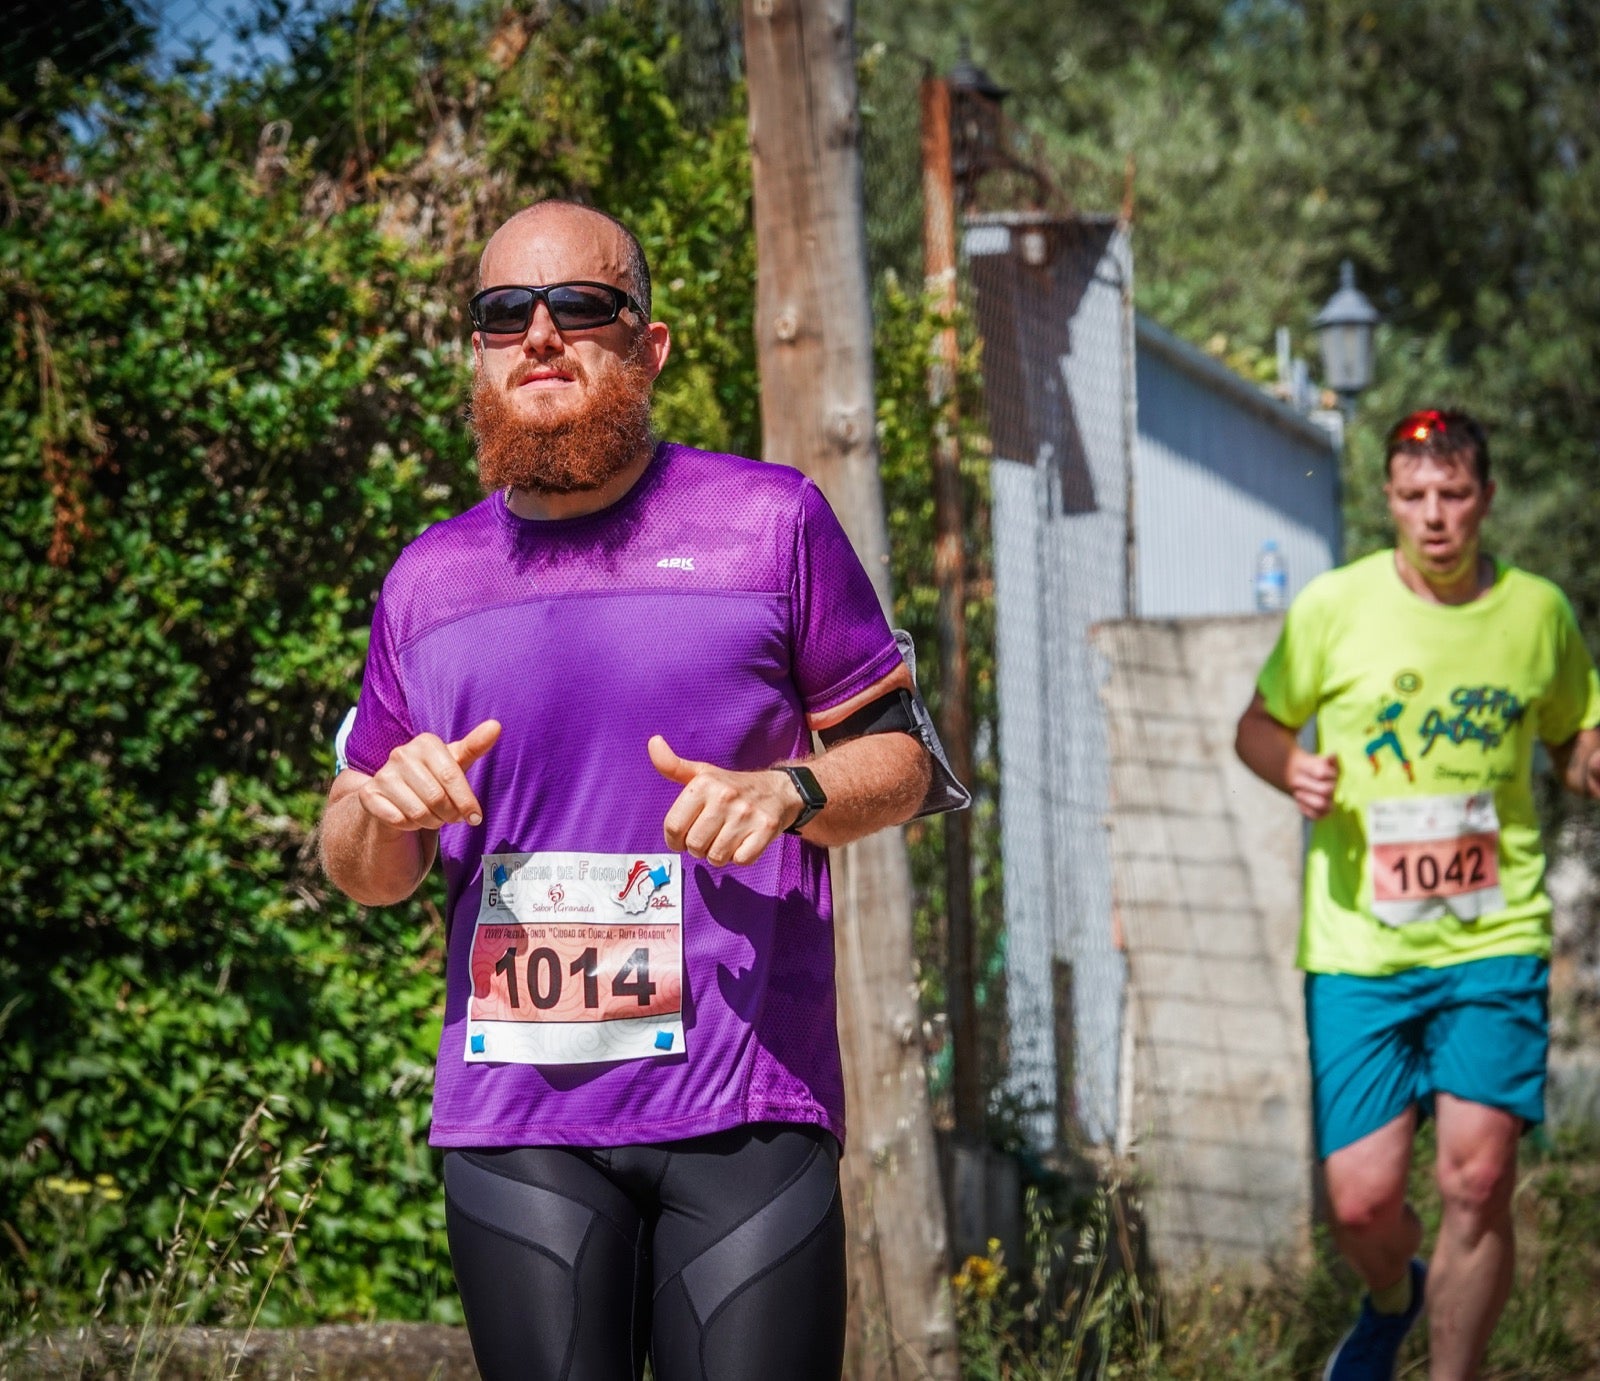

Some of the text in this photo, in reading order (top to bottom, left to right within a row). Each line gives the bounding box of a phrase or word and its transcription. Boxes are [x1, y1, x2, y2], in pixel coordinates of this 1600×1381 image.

[578, 860, 626, 881] FONDO
[1391, 846, 1486, 893] 1042
[532, 902, 596, 913] Sabor Granada
[495, 946, 657, 1010] 1014
